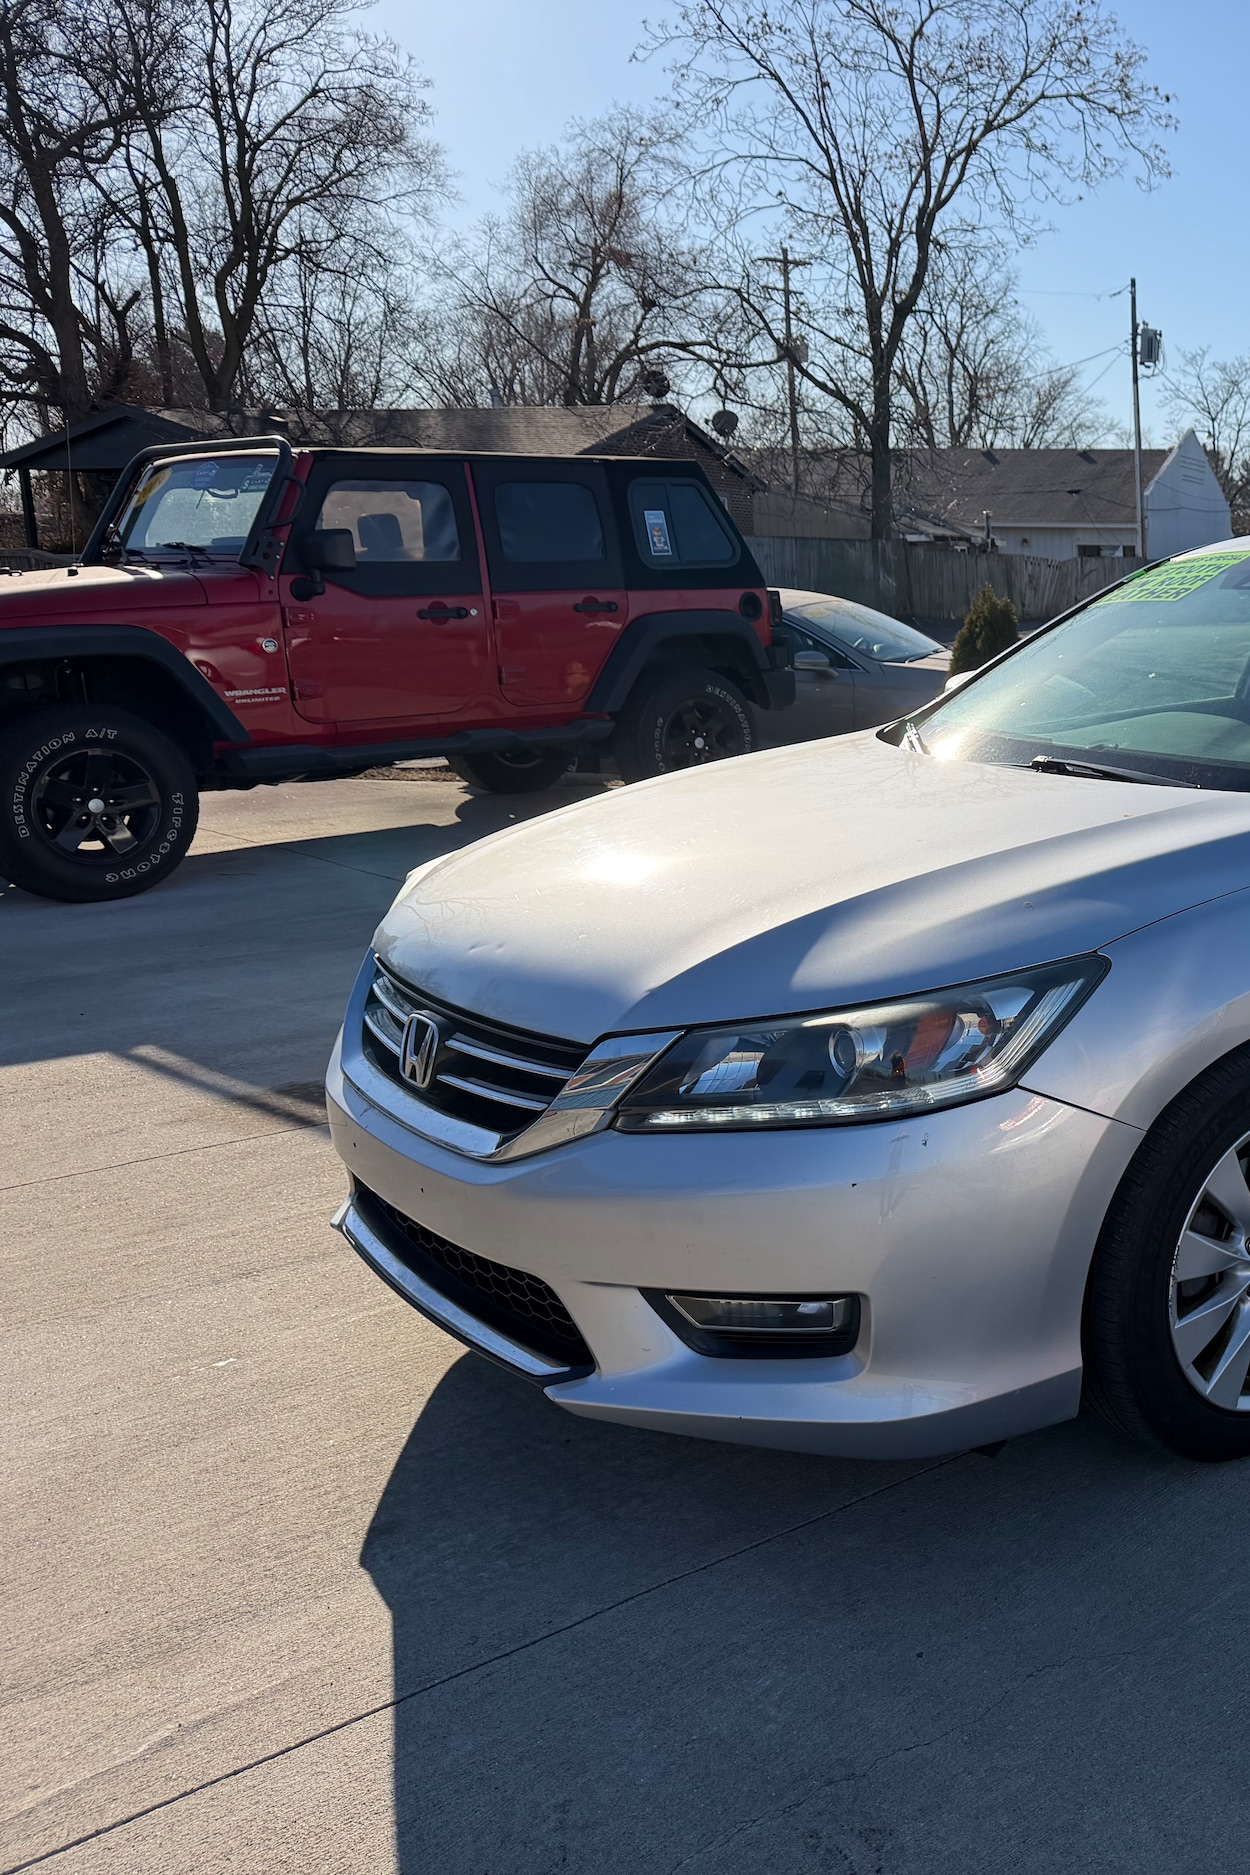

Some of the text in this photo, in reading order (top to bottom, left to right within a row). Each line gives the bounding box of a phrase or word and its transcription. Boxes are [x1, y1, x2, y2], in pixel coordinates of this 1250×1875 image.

[224, 687, 287, 697] WRANGLER
[235, 696, 281, 704] UNLIMITED
[12, 728, 118, 838] DESTINATION A/T
[105, 792, 184, 882] Firestone
